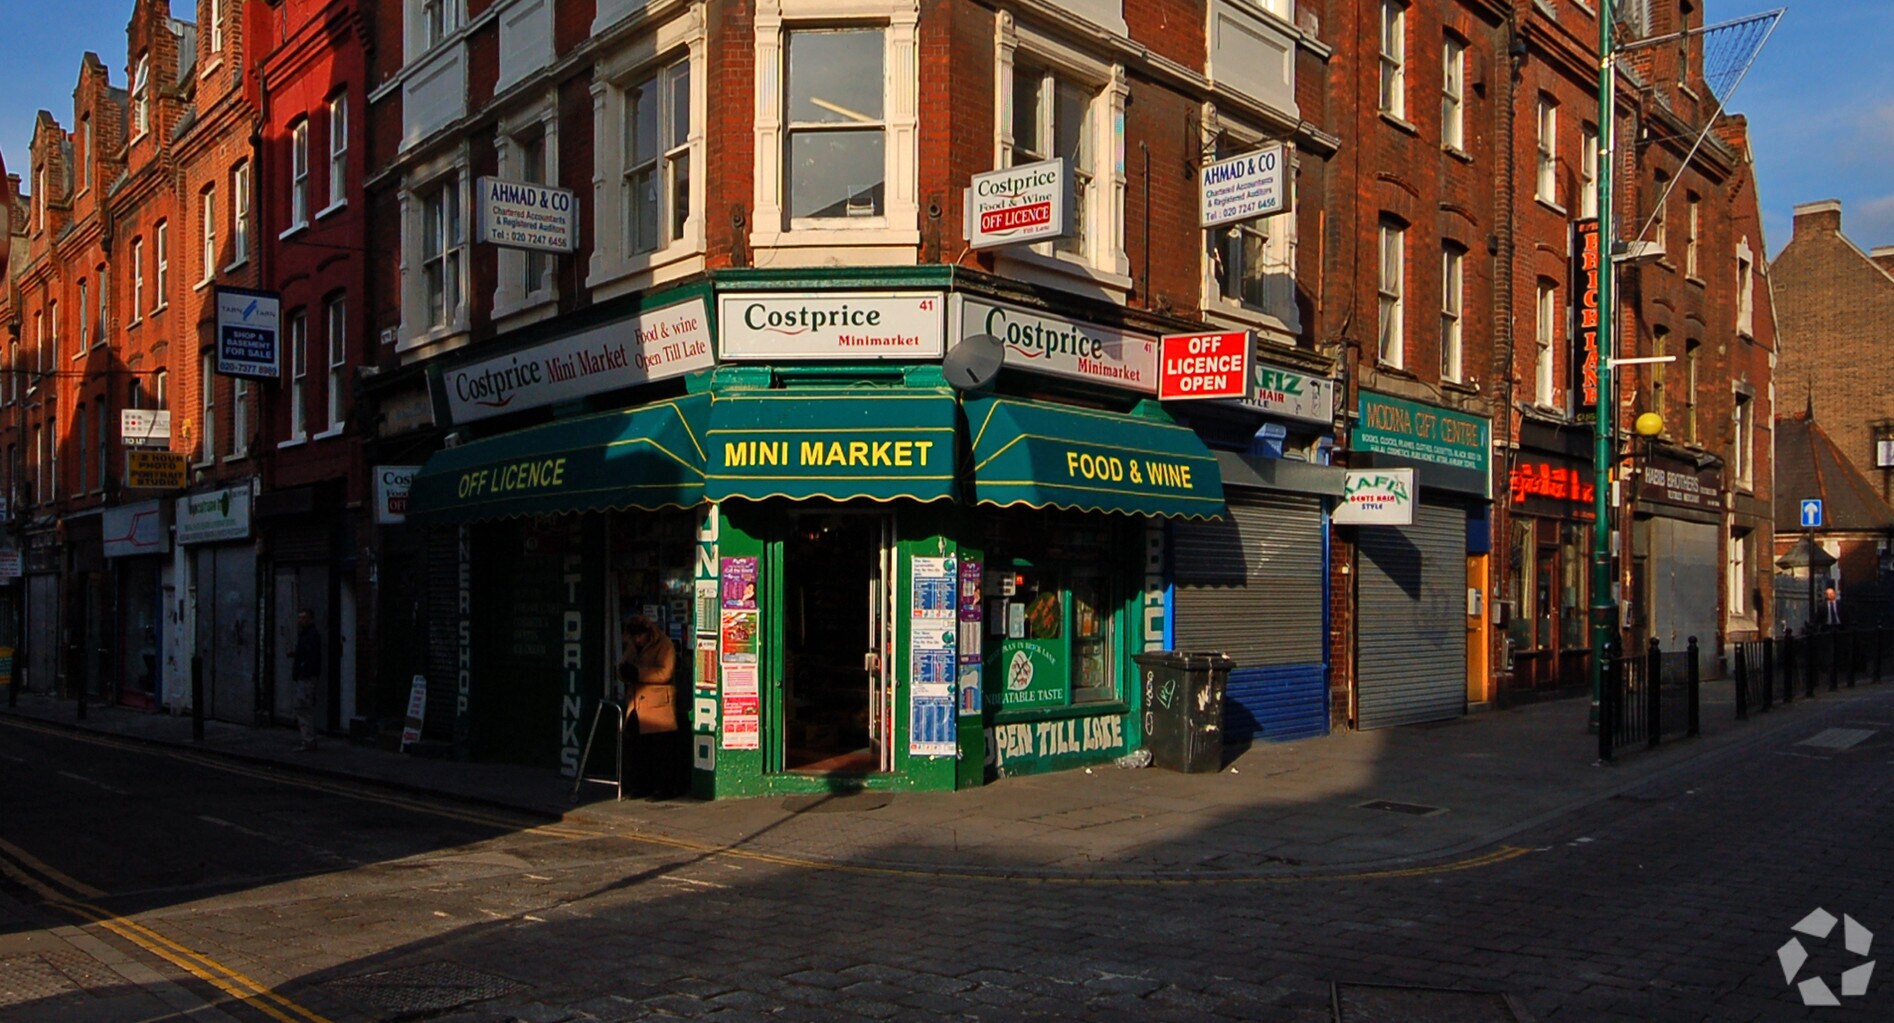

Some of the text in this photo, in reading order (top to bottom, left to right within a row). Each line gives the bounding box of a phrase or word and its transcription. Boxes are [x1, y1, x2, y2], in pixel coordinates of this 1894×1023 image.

[1204, 152, 1275, 186] AHMAD & CO
[978, 170, 1056, 197] Costprice
[1206, 177, 1273, 198] Chartered Accountants
[490, 182, 569, 211] AHMAD & CO
[979, 193, 1052, 212] Food & Wine
[1214, 192, 1245, 207] Registered
[1246, 187, 1272, 198] Auditors
[492, 206, 566, 224] Chartered Accountants
[982, 206, 1049, 230] OFF LICENCE
[1223, 206, 1237, 217] 020
[1238, 202, 1256, 214] 7247
[503, 217, 537, 230] Registered
[539, 223, 566, 234] Auditors
[511, 231, 526, 242] 020
[528, 233, 546, 244] 7247
[744, 300, 933, 332] Costprice 41
[233, 331, 256, 339] SHOP
[634, 316, 699, 347] Food & wine
[838, 334, 919, 347] Minimarket
[985, 306, 1152, 359] Costprice 41
[225, 347, 272, 359] FOR SALE
[226, 338, 271, 350] BASEMENT
[1188, 336, 1222, 354] OFF
[634, 340, 707, 372] Open Till Late
[1167, 355, 1242, 375] LICENCE
[456, 343, 629, 403] Costprice Mini Market
[1078, 357, 1141, 382] Minimarket
[1179, 375, 1227, 392] OPEN
[1259, 389, 1285, 403] HAIR
[1367, 401, 1479, 447] MODINA GIFT CENTRE
[152, 454, 183, 462] HOUR
[724, 441, 933, 467] MINI MARKET
[458, 458, 565, 499] OFF LICENCE
[1066, 451, 1193, 489] FOOD & WINE
[1645, 466, 1665, 487] HABIB
[1666, 471, 1699, 493] BROTHERS
[137, 478, 178, 486] STUDIO
[456, 619, 471, 717] SHOP
[560, 611, 582, 776] DRINKS
[985, 688, 1063, 705] NBEATABLE TASTE
[1037, 718, 1080, 758] TILL
[1082, 714, 1123, 752] LATE
